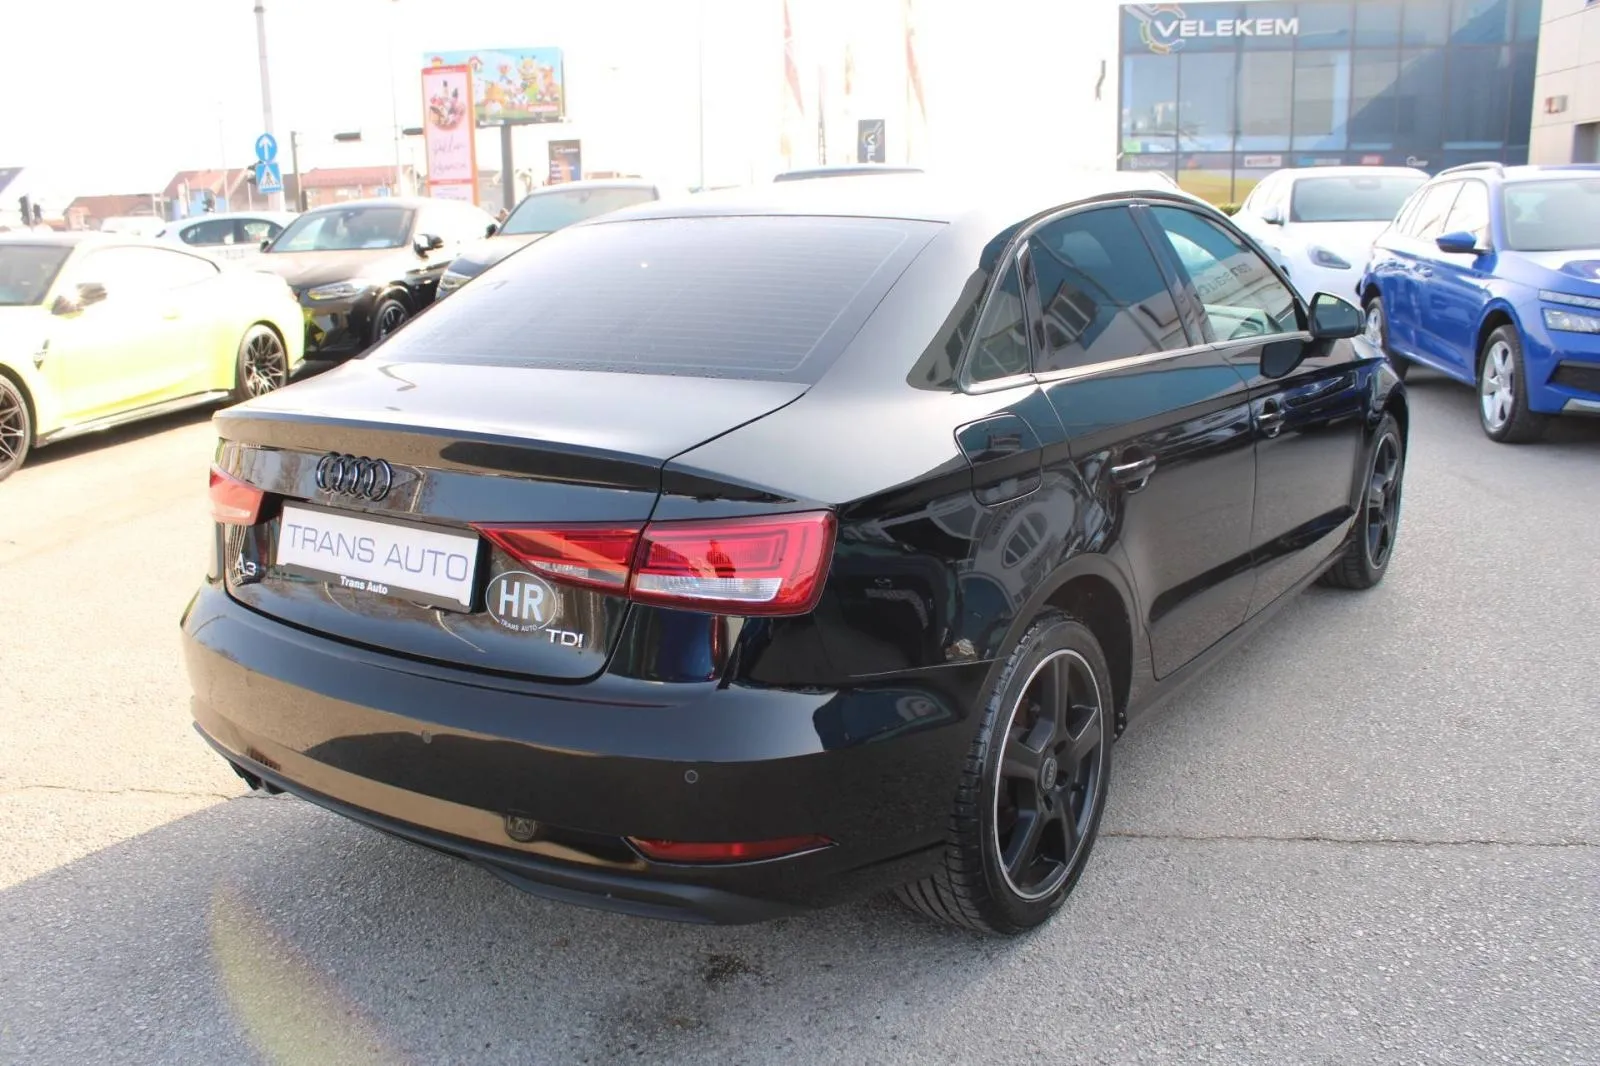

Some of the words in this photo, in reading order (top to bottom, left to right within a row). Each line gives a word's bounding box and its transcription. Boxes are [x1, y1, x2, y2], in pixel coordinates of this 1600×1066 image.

[1154, 17, 1299, 37] VELEKEM
[287, 523, 376, 563] TRANS
[383, 543, 469, 582] AUTO
[233, 552, 257, 576] A3
[340, 575, 366, 591] Trans
[366, 581, 389, 595] Auto
[498, 579, 544, 622] HR
[521, 624, 538, 632] AUTO
[545, 628, 584, 648] TDI
